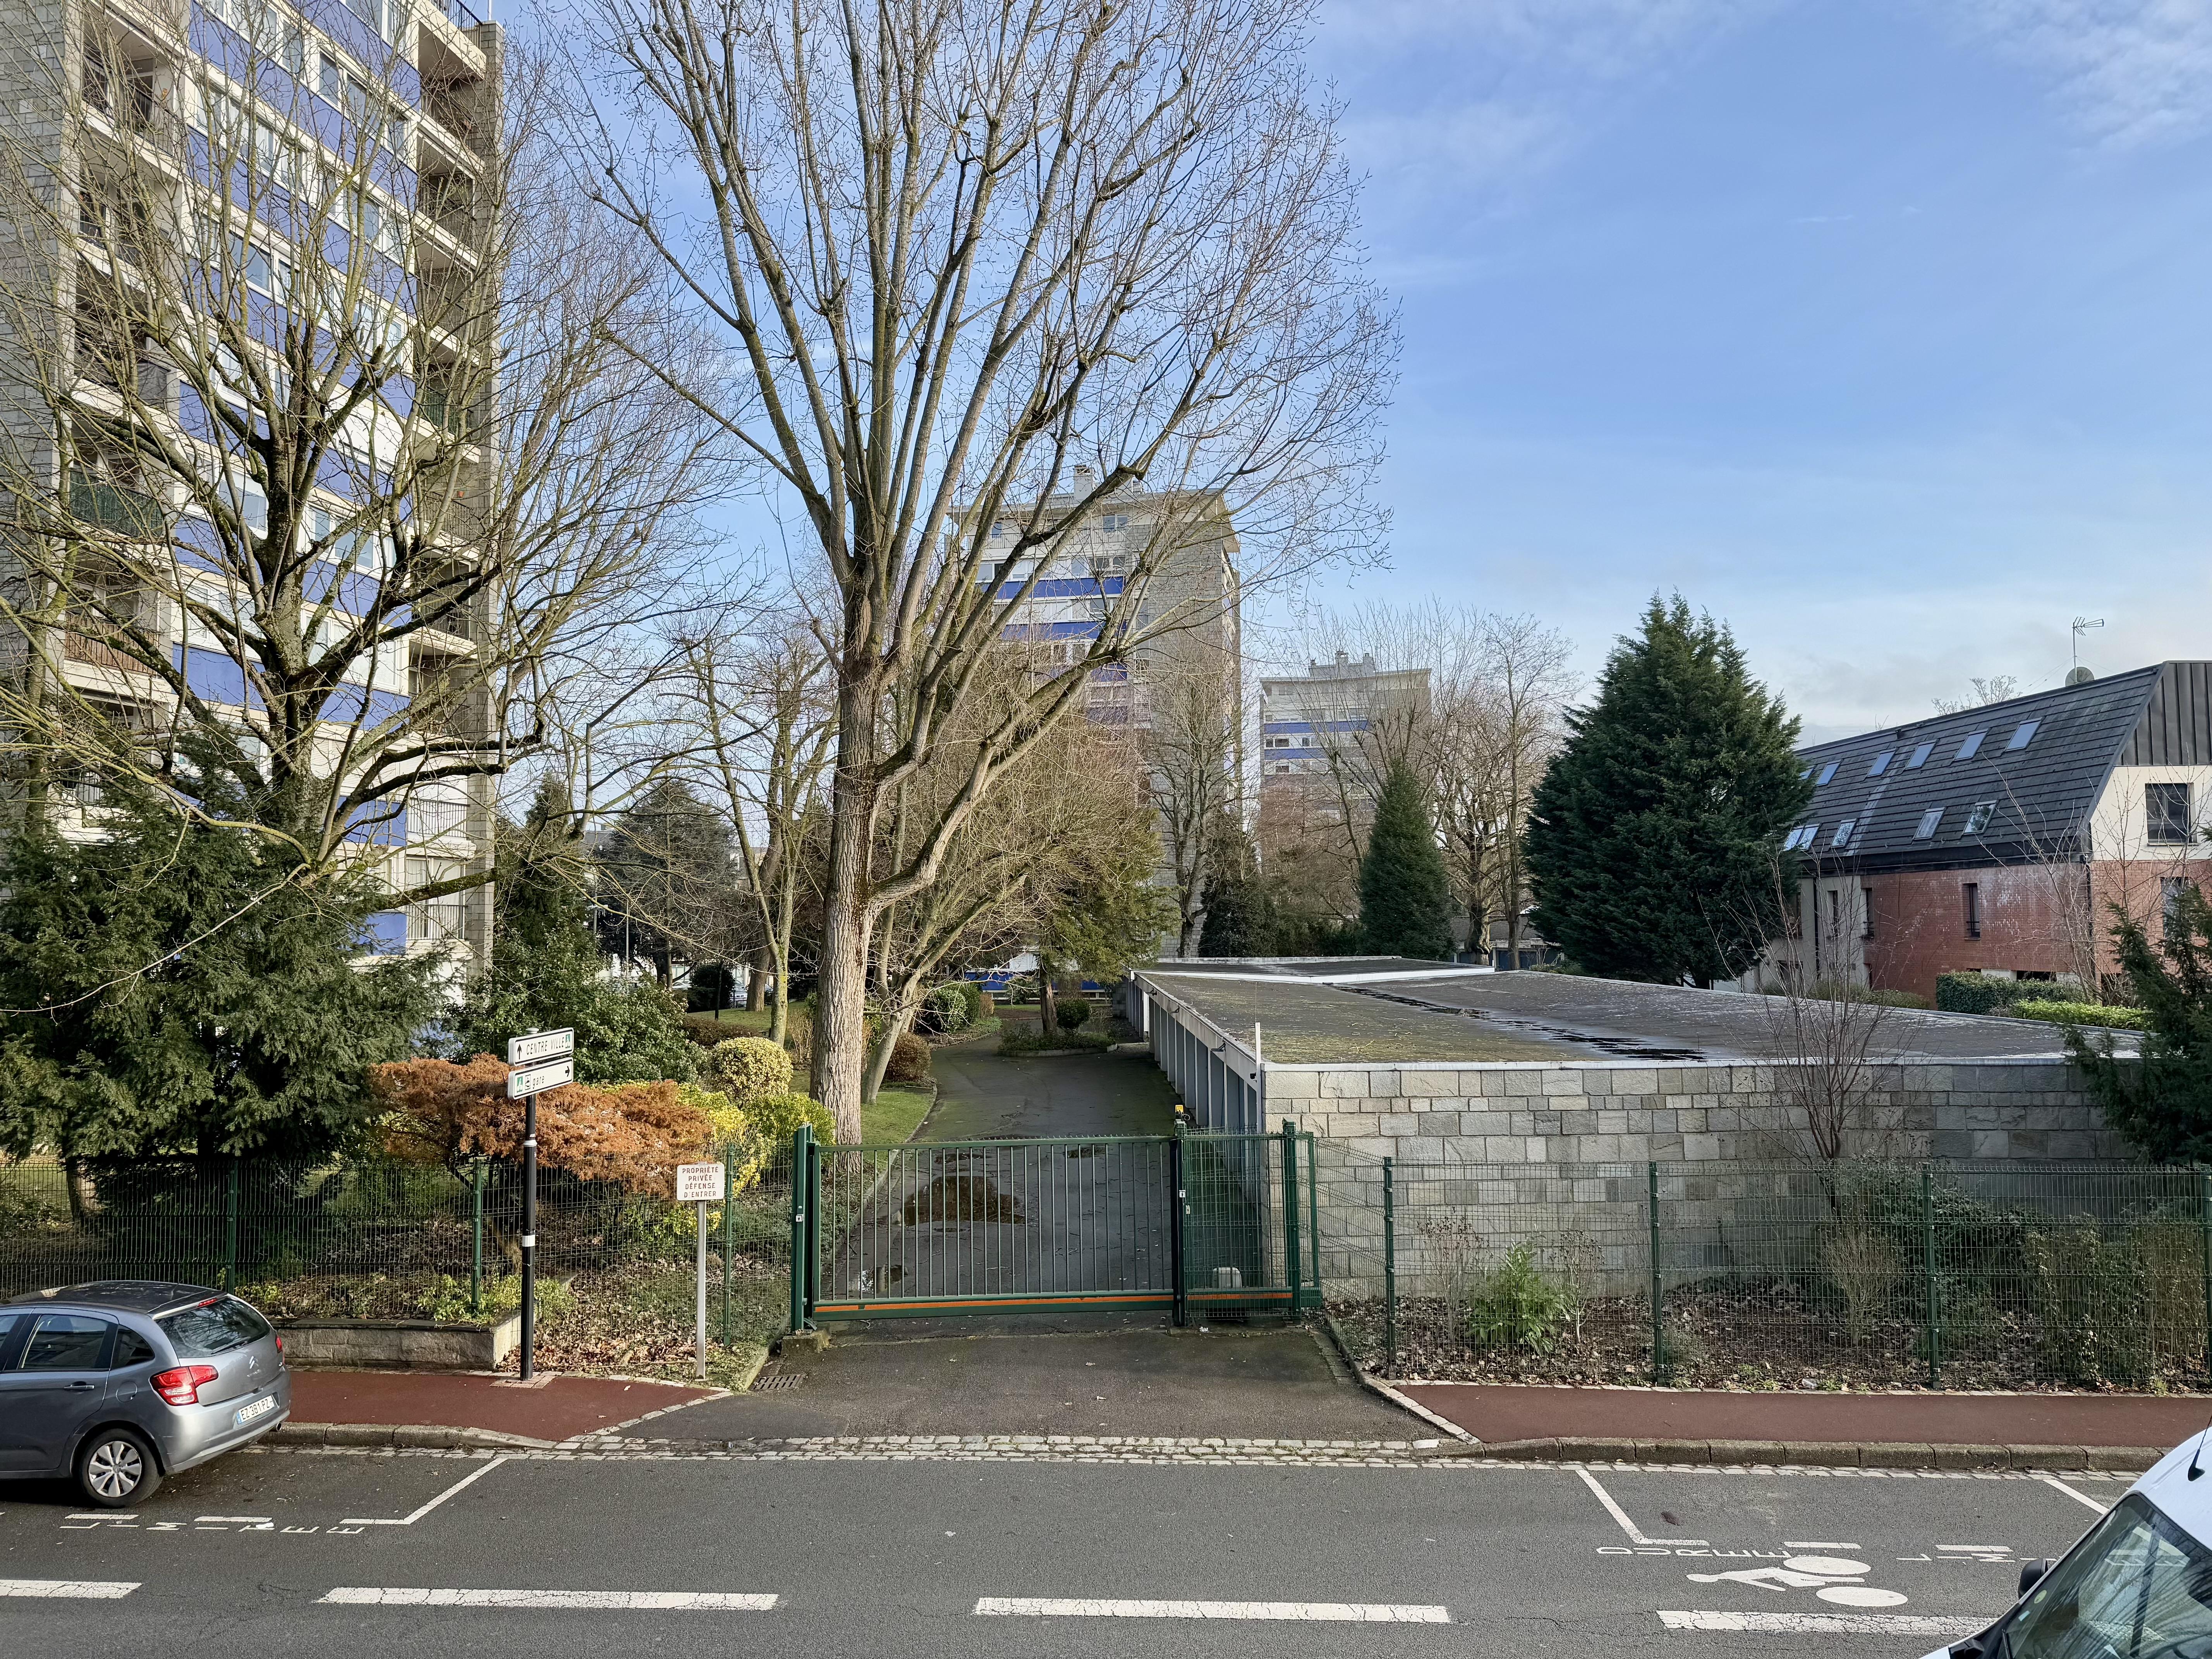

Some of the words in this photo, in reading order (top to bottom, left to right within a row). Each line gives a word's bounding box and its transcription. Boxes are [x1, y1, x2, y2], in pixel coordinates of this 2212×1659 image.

[526, 1041, 548, 1055] CENTRE
[551, 1037, 564, 1050] VILLE
[532, 1075, 544, 1089] gare
[1595, 1546, 1793, 1558] DUREE
